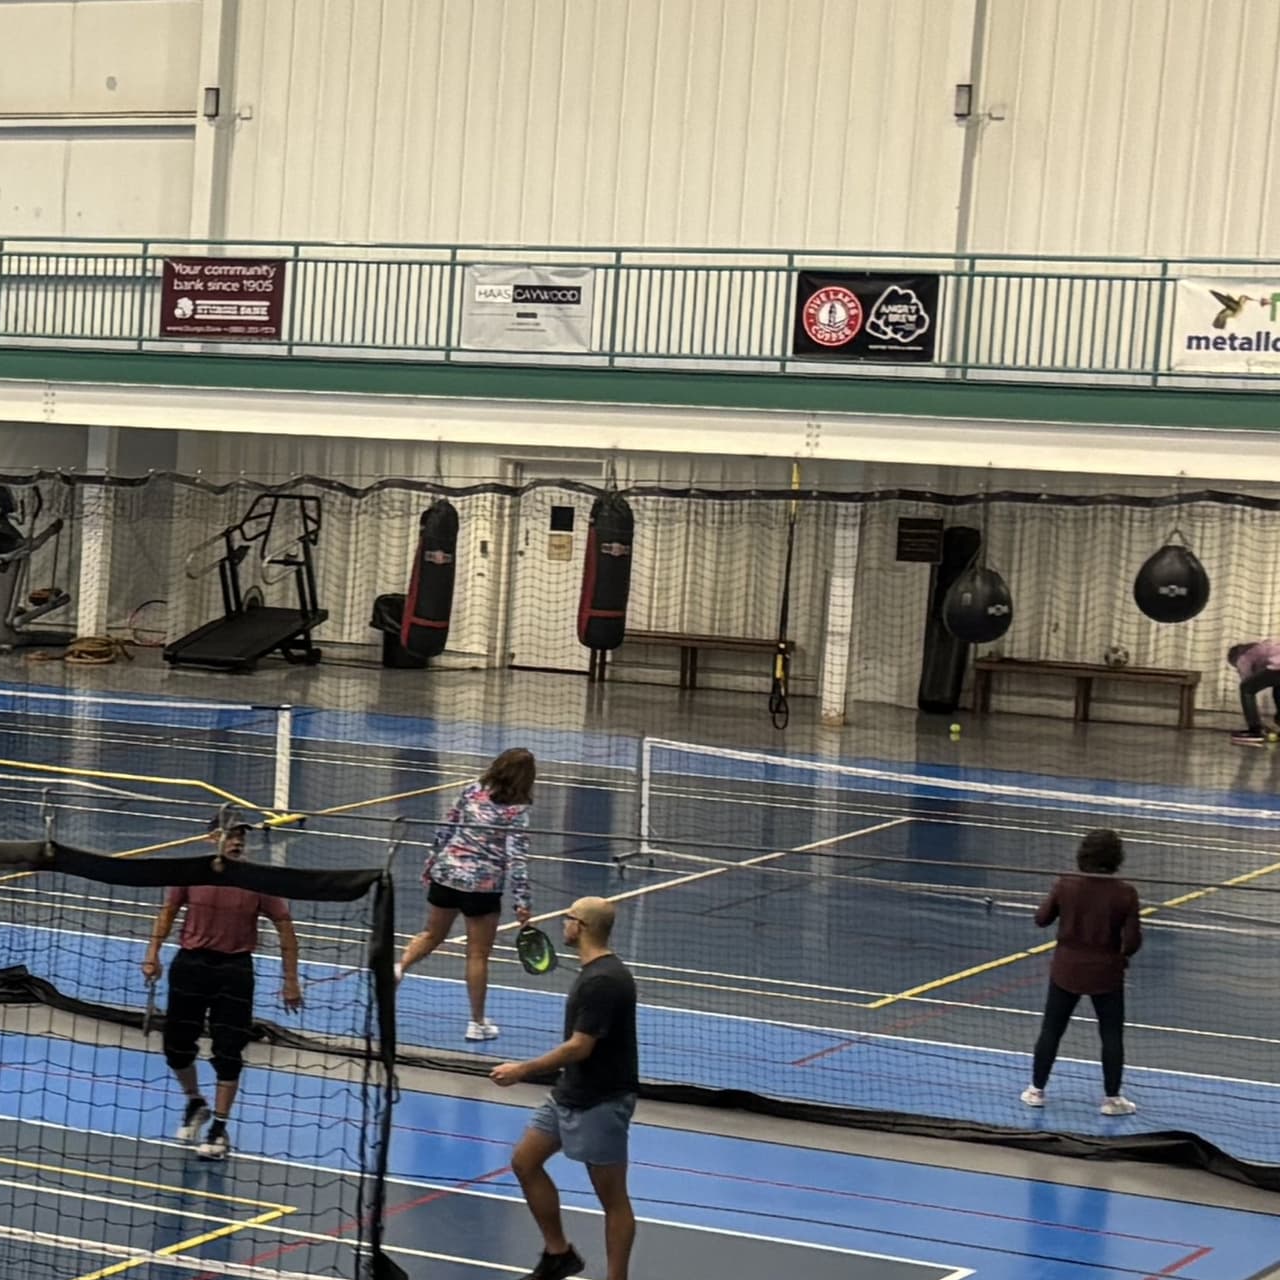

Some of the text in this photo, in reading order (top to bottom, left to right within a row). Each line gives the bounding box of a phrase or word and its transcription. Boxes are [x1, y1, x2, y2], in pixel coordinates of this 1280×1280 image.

[172, 263, 276, 278] Your community
[173, 278, 274, 292] bank since 1905
[478, 288, 578, 301] HAAS CAYWOOD
